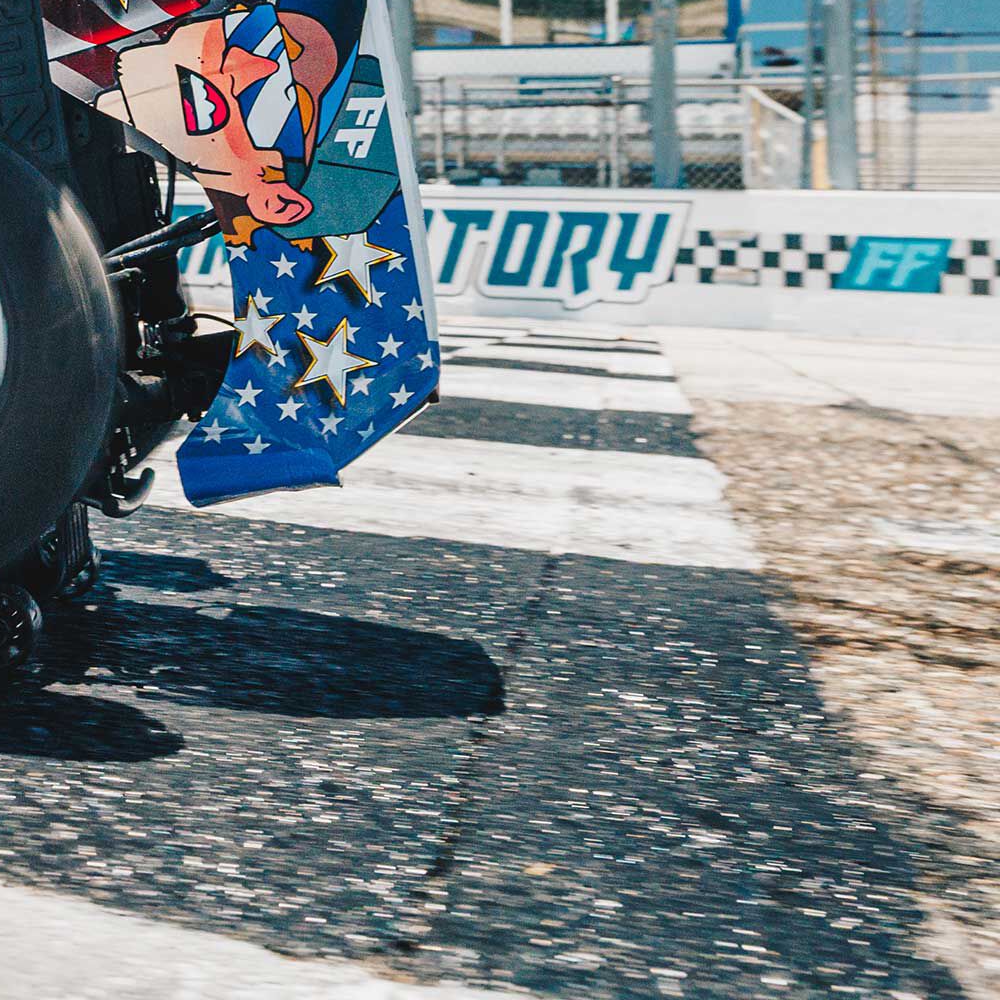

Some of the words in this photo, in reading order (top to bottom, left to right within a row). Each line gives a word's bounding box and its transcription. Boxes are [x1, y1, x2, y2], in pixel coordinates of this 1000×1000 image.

[333, 93, 386, 159] FF
[424, 208, 671, 296] TORY
[854, 240, 943, 288] FF
